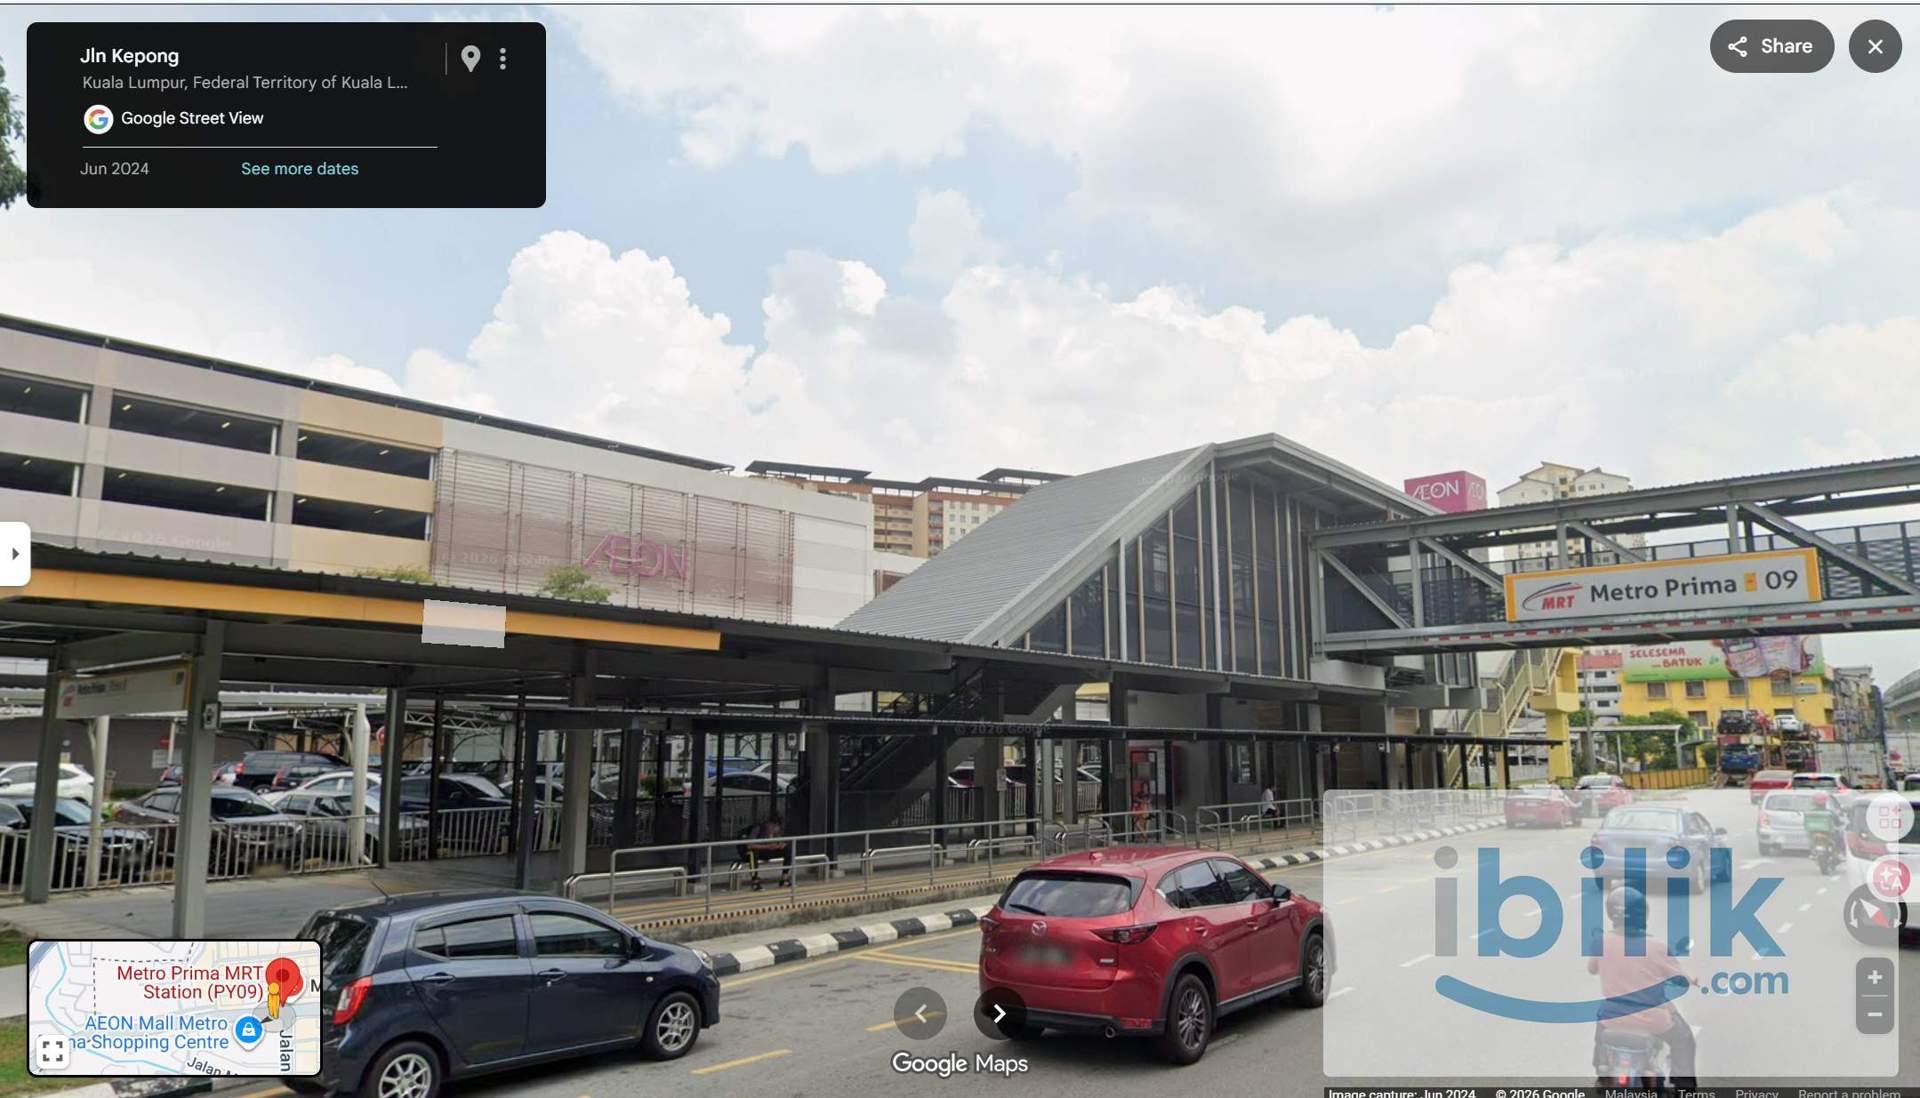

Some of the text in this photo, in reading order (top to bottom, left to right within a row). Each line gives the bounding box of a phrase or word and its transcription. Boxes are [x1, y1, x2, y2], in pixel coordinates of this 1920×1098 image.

[1541, 570, 1798, 610] MRT Metro Prima 09
[1663, 658, 1702, 668] BATUK
